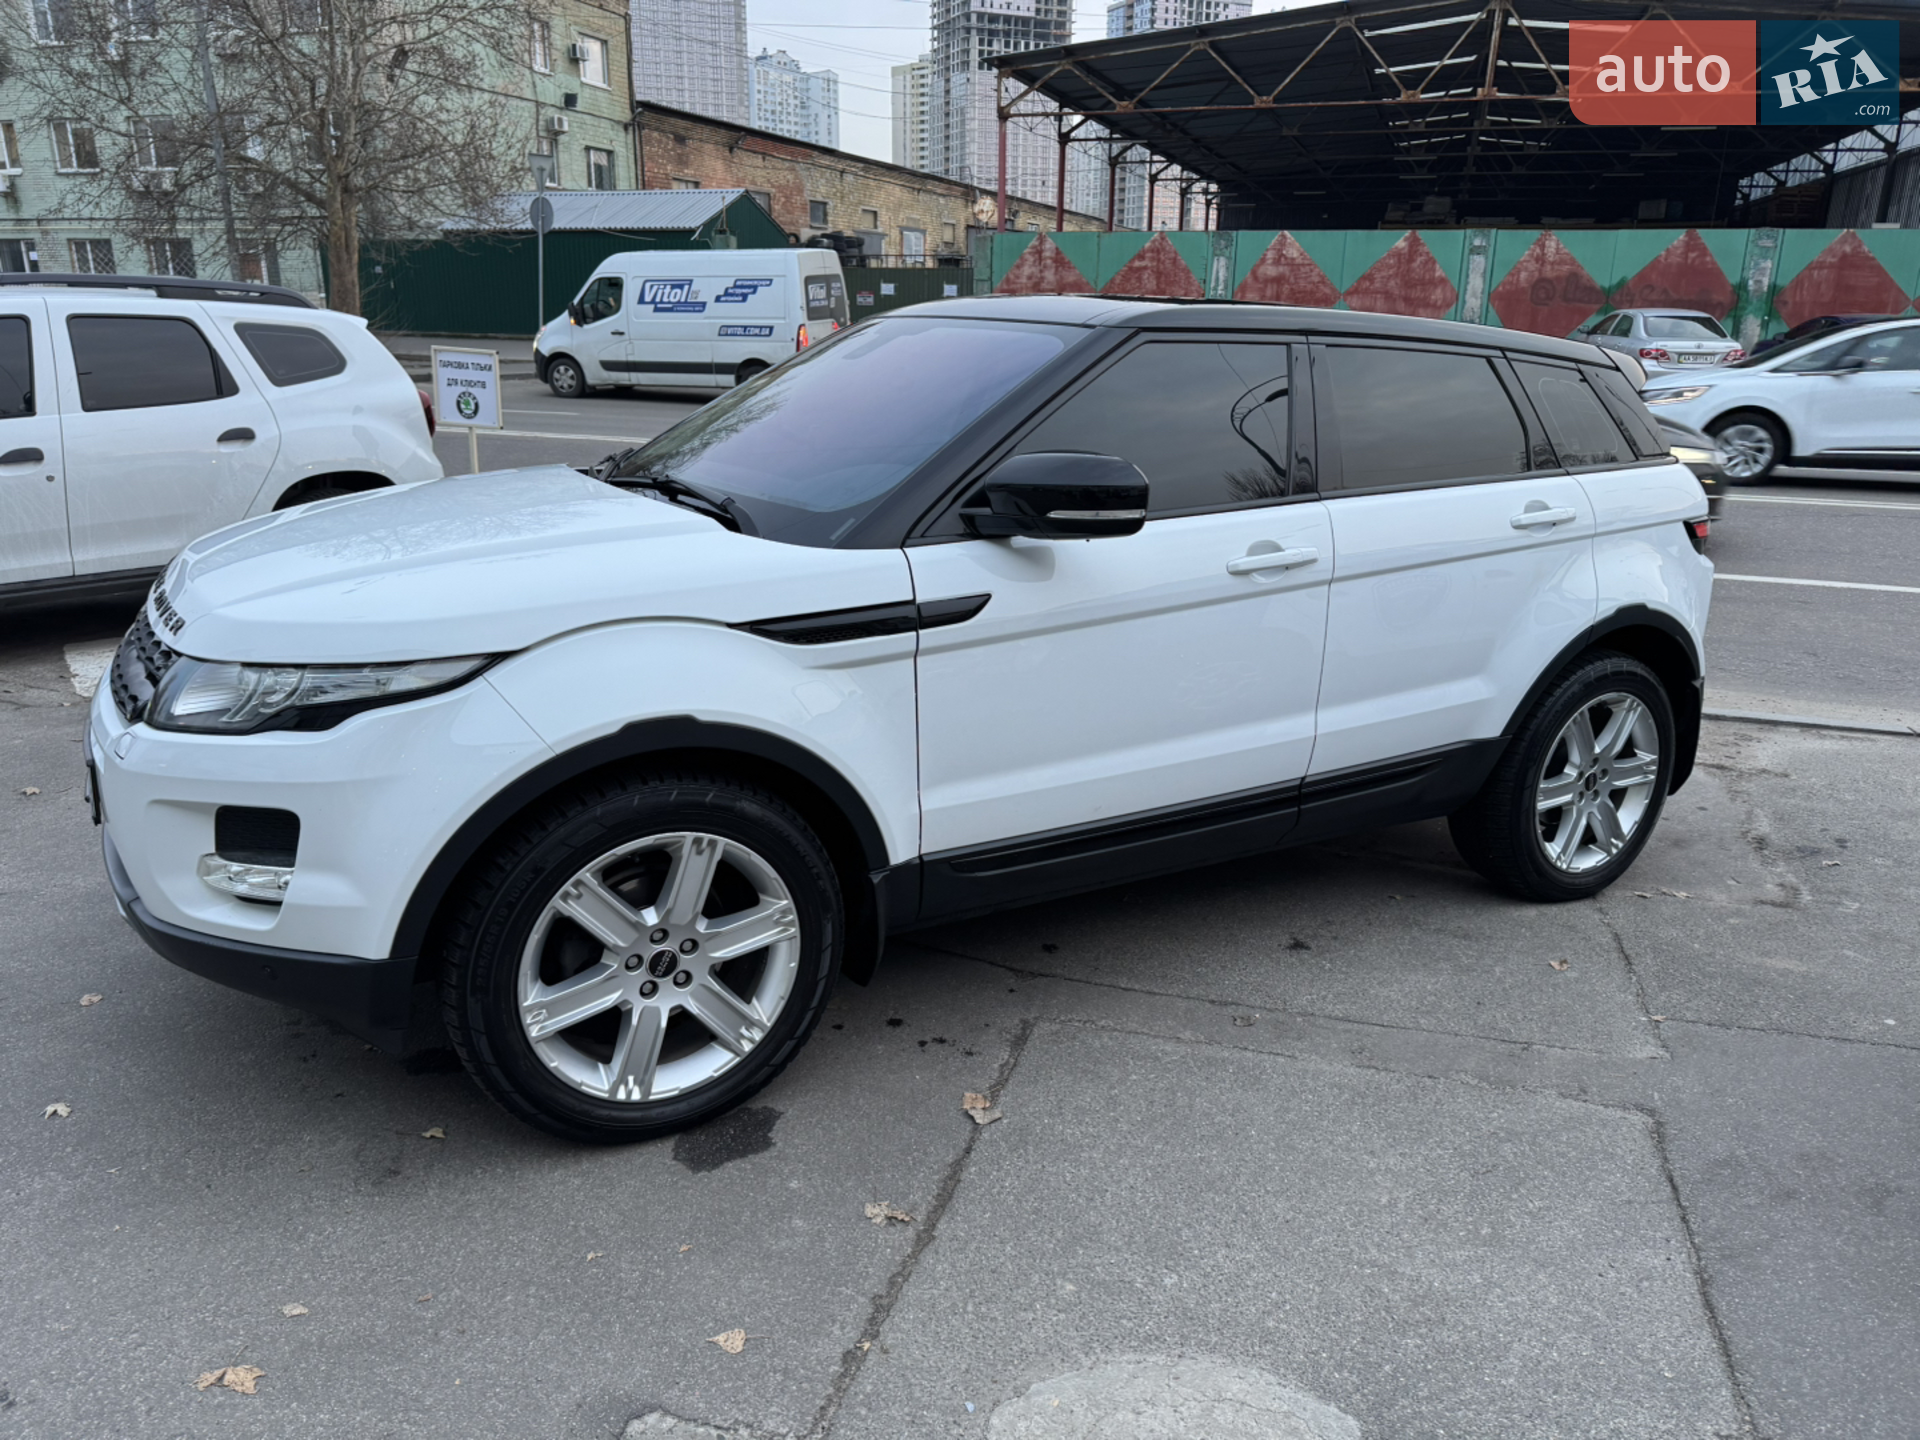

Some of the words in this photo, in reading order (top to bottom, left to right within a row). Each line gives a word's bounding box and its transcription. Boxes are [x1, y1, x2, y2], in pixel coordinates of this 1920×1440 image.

[644, 283, 690, 302] Vitol
[439, 359, 470, 370] ПАРКОВКА
[470, 362, 493, 372] ТІЛЬКИ
[446, 378, 459, 387] ДЛЯ
[460, 379, 487, 389] КЛІЄНТІВ
